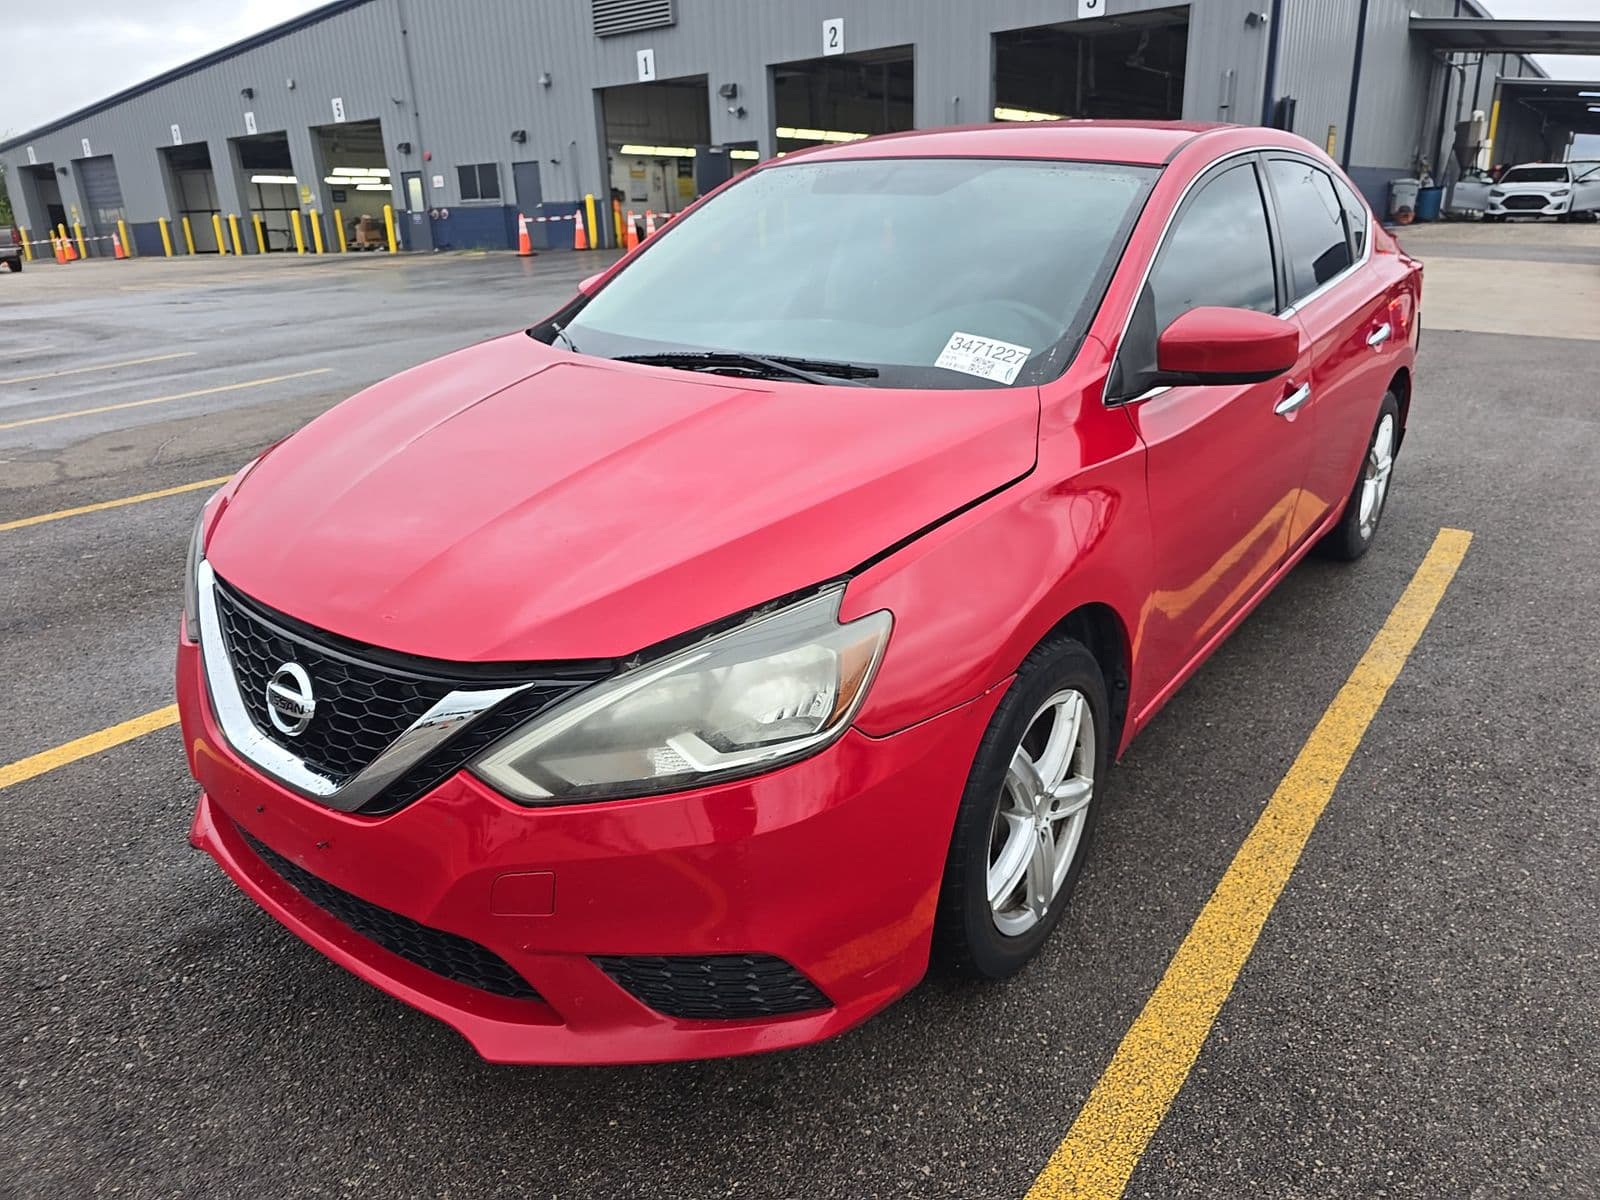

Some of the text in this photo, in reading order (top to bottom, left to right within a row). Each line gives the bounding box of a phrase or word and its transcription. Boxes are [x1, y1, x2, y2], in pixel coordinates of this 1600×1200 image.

[828, 26, 838, 48] 2
[643, 55, 649, 76] 1
[950, 337, 1029, 365] 3471227
